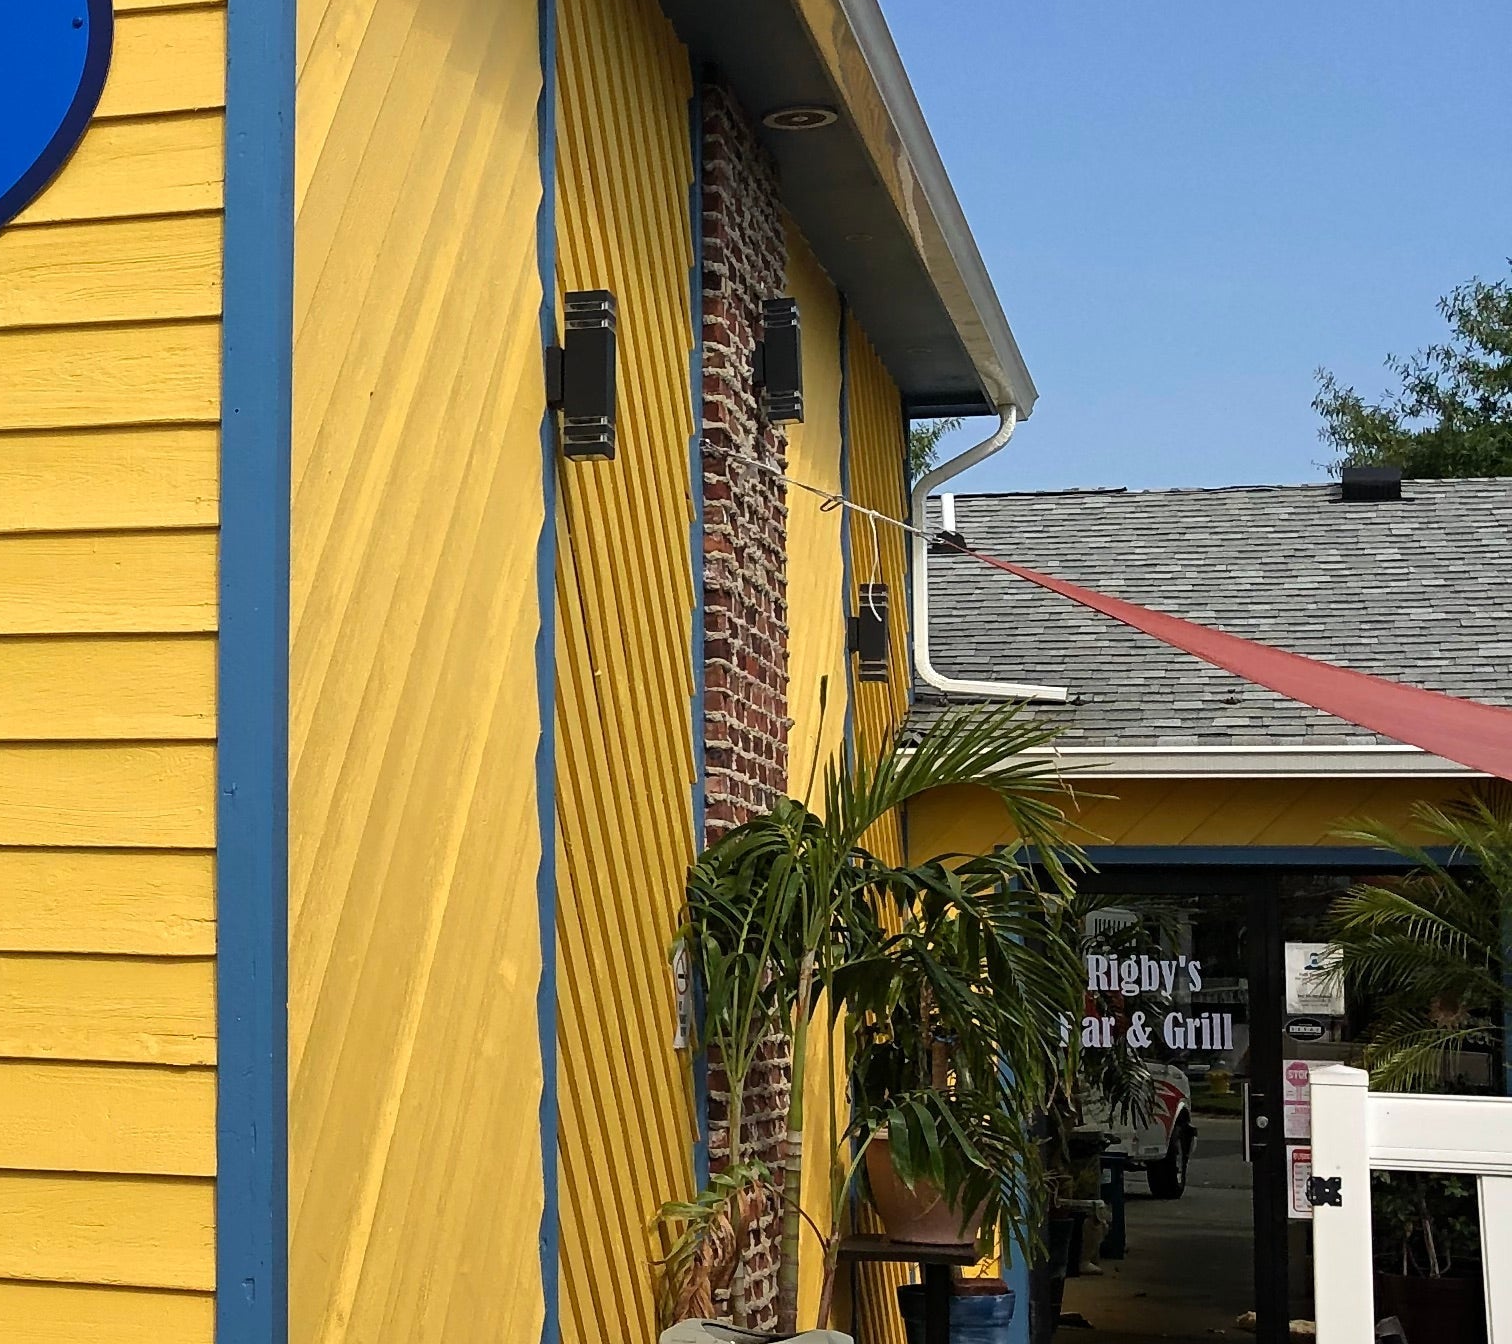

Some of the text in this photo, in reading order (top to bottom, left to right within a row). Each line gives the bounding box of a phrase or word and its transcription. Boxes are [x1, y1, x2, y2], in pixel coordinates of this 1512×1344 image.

[1087, 953, 1203, 998] Rigby's
[1126, 1011, 1153, 1049] &
[1163, 1011, 1235, 1051] Grill
